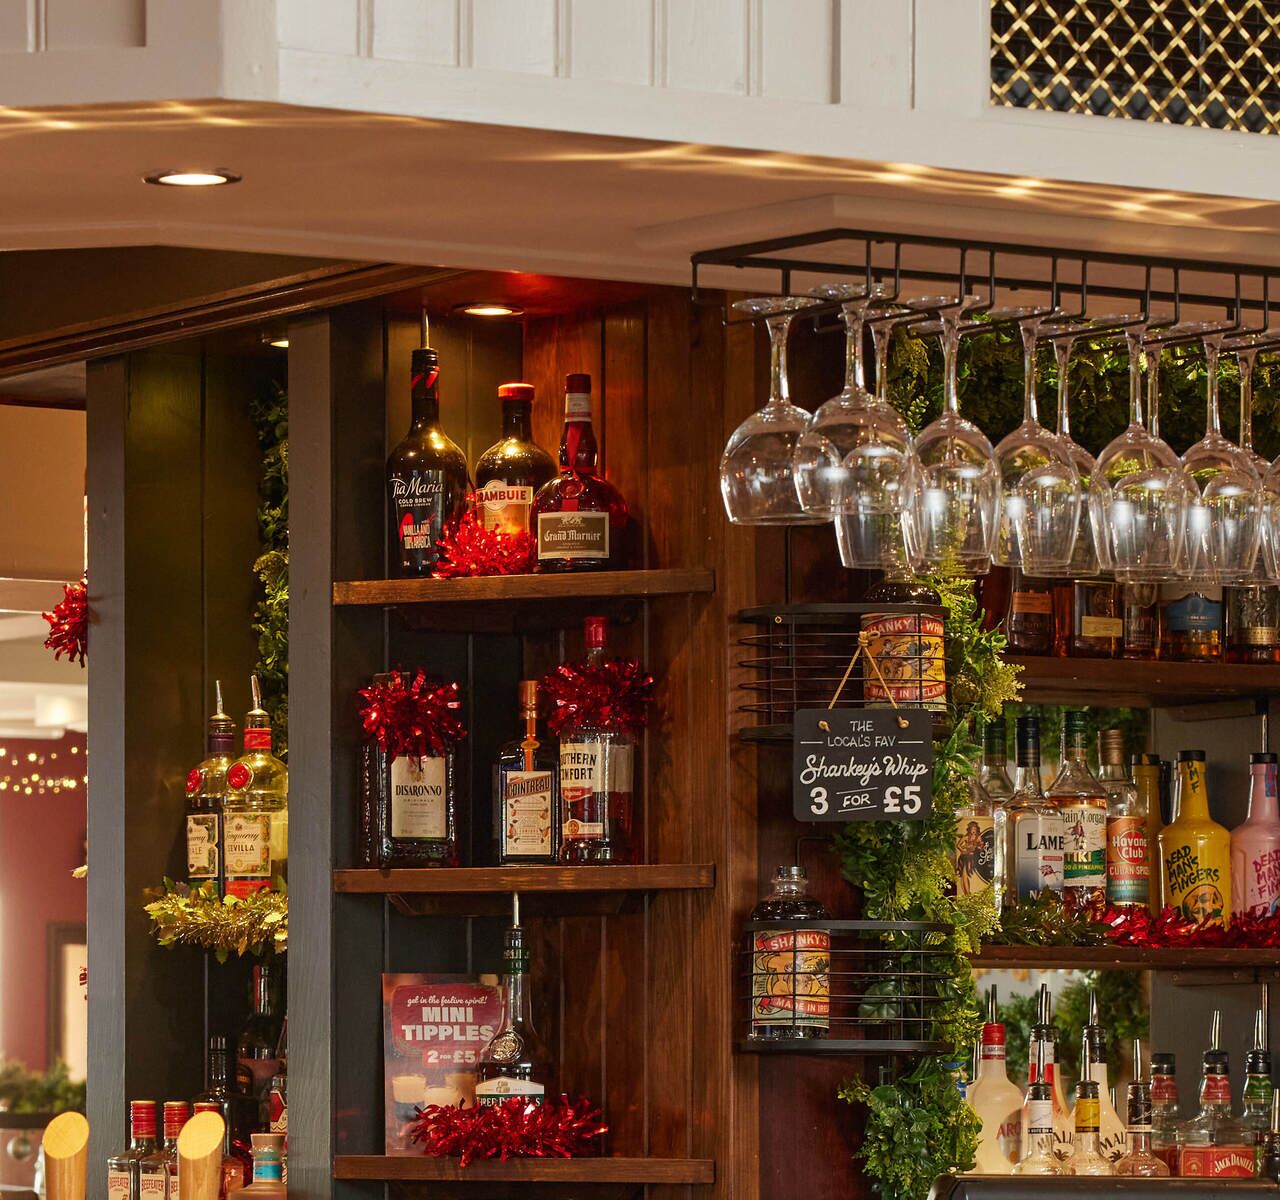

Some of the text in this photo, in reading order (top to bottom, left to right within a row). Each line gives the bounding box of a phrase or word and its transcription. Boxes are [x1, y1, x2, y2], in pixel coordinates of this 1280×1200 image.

[389, 476, 443, 498] Tia Maria
[900, 689, 910, 698] IN
[850, 720, 874, 732] THE
[827, 734, 897, 747] LOCAL'S FAV
[560, 752, 597, 766] OUTHERN
[561, 768, 593, 780] OMFORT
[800, 753, 929, 787] Shankey's Whip
[395, 784, 442, 797] DISARONNO
[507, 775, 551, 797] COINTREAU
[810, 785, 922, 815] 3 FOR £5
[227, 844, 255, 852] SEVILLA
[1122, 846, 1143, 858] Club
[1065, 851, 1092, 863] TIKI
[1166, 845, 1192, 871] DEAD
[1170, 868, 1220, 896] FINGERS
[407, 995, 419, 1008] get
[420, 996, 428, 1004] in
[428, 994, 440, 1004] the
[440, 995, 464, 1007] festive
[807, 1003, 816, 1012] IN
[422, 1006, 474, 1023] MINI
[401, 1024, 495, 1041] TIPPLES
[427, 1050, 439, 1063] 2
[453, 1050, 476, 1063] £5
[1214, 1157, 1231, 1173] JACK
[109, 1176, 129, 1190] BEEFEATER
[141, 1178, 165, 1192] BEEFEATER
